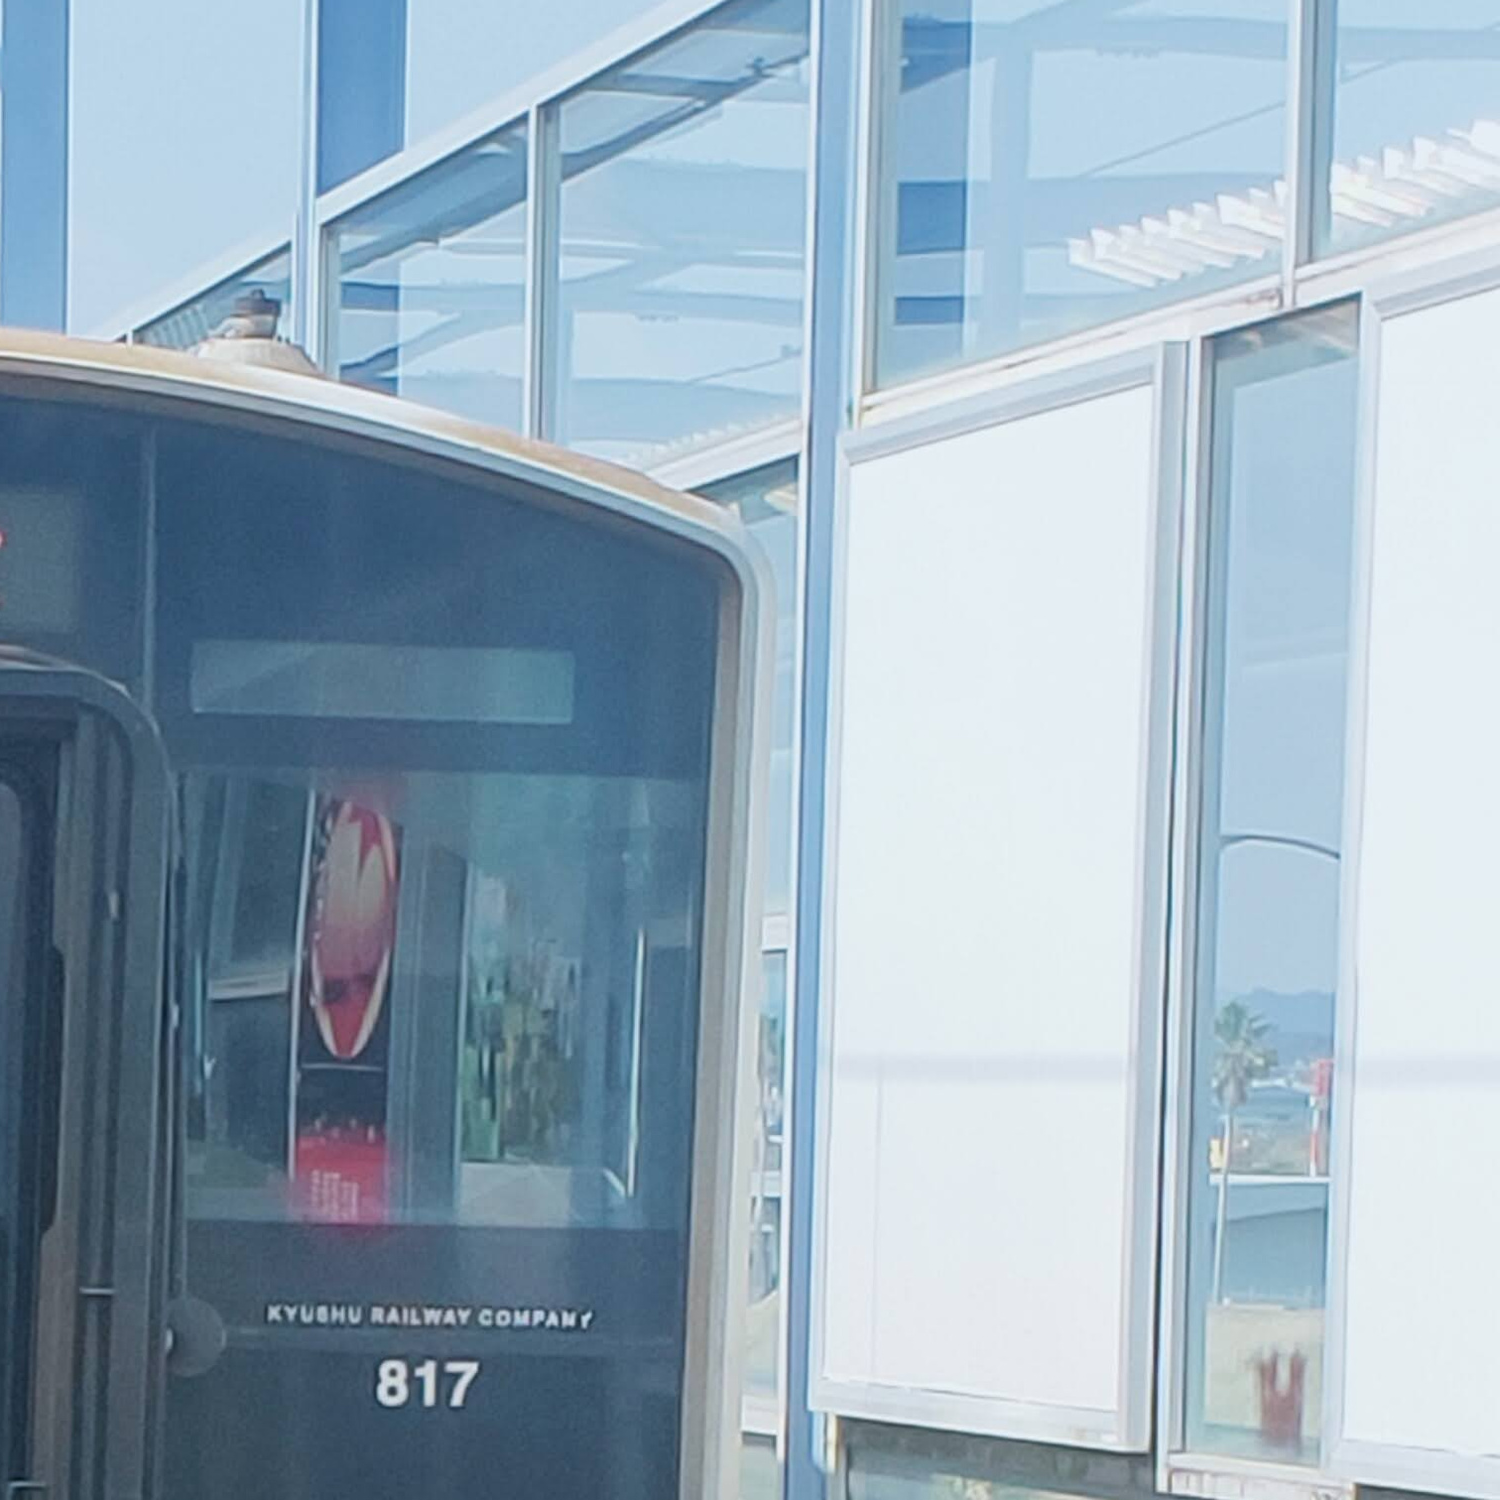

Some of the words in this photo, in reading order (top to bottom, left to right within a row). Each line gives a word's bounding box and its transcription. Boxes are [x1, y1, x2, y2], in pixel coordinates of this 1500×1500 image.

[266, 1304, 363, 1326] KYUSHU
[370, 1306, 472, 1327] RAILWAY
[478, 1308, 594, 1330] COMPANY
[375, 1359, 480, 1408] 817
